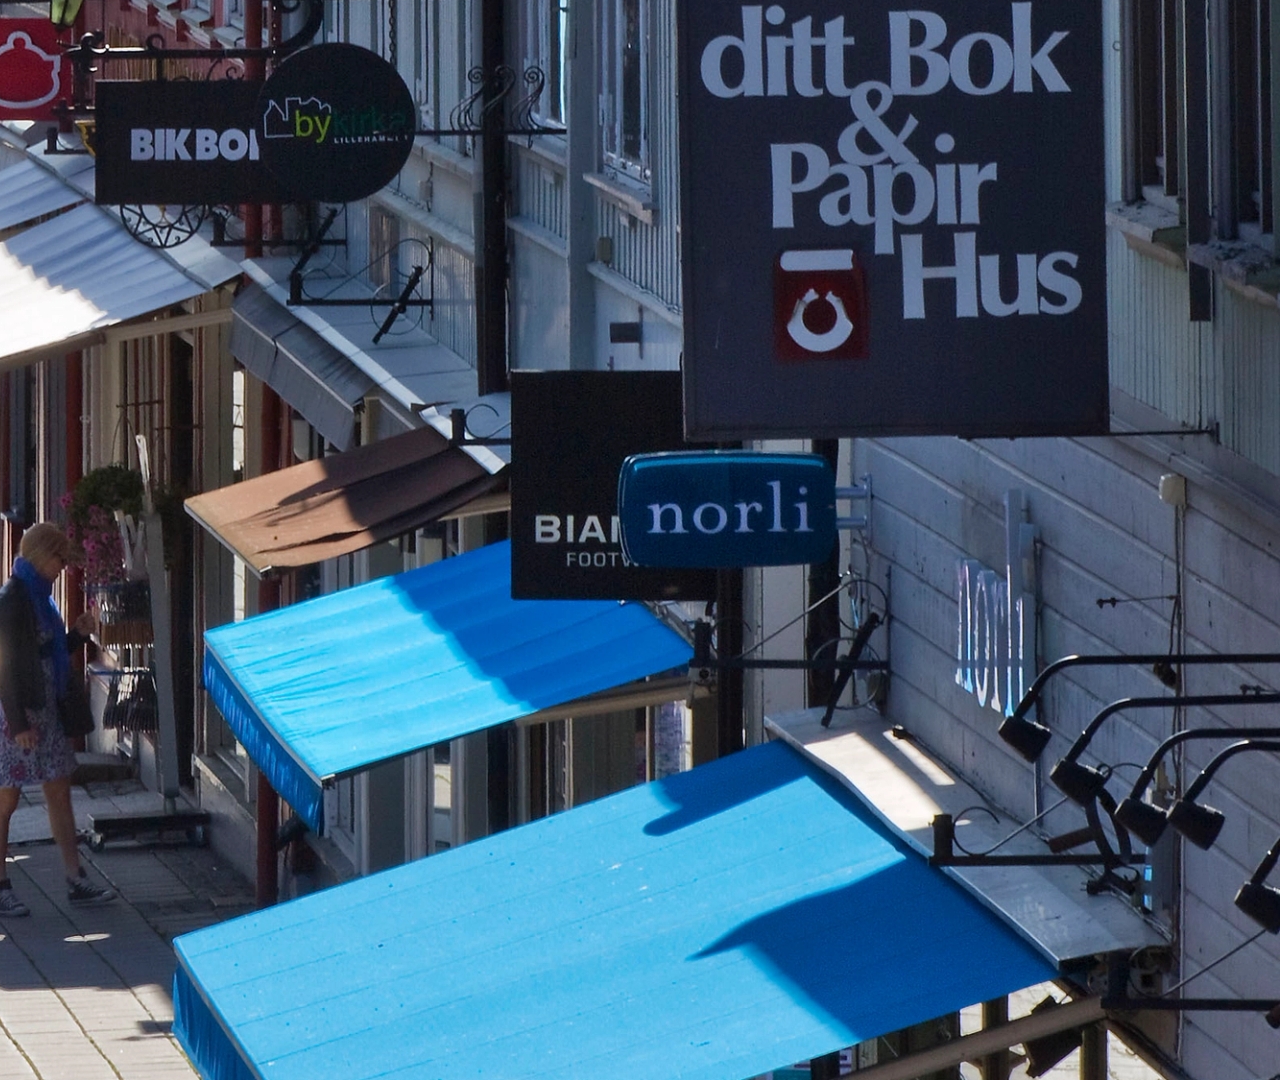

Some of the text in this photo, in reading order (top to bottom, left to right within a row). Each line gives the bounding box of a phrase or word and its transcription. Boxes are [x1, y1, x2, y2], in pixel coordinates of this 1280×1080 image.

[700, 1, 1071, 98] ditt Bok
[130, 128, 192, 161] BIK
[838, 80, 920, 167] &
[771, 133, 998, 255] Papir
[901, 233, 1083, 321] Hus
[646, 480, 814, 535] norli
